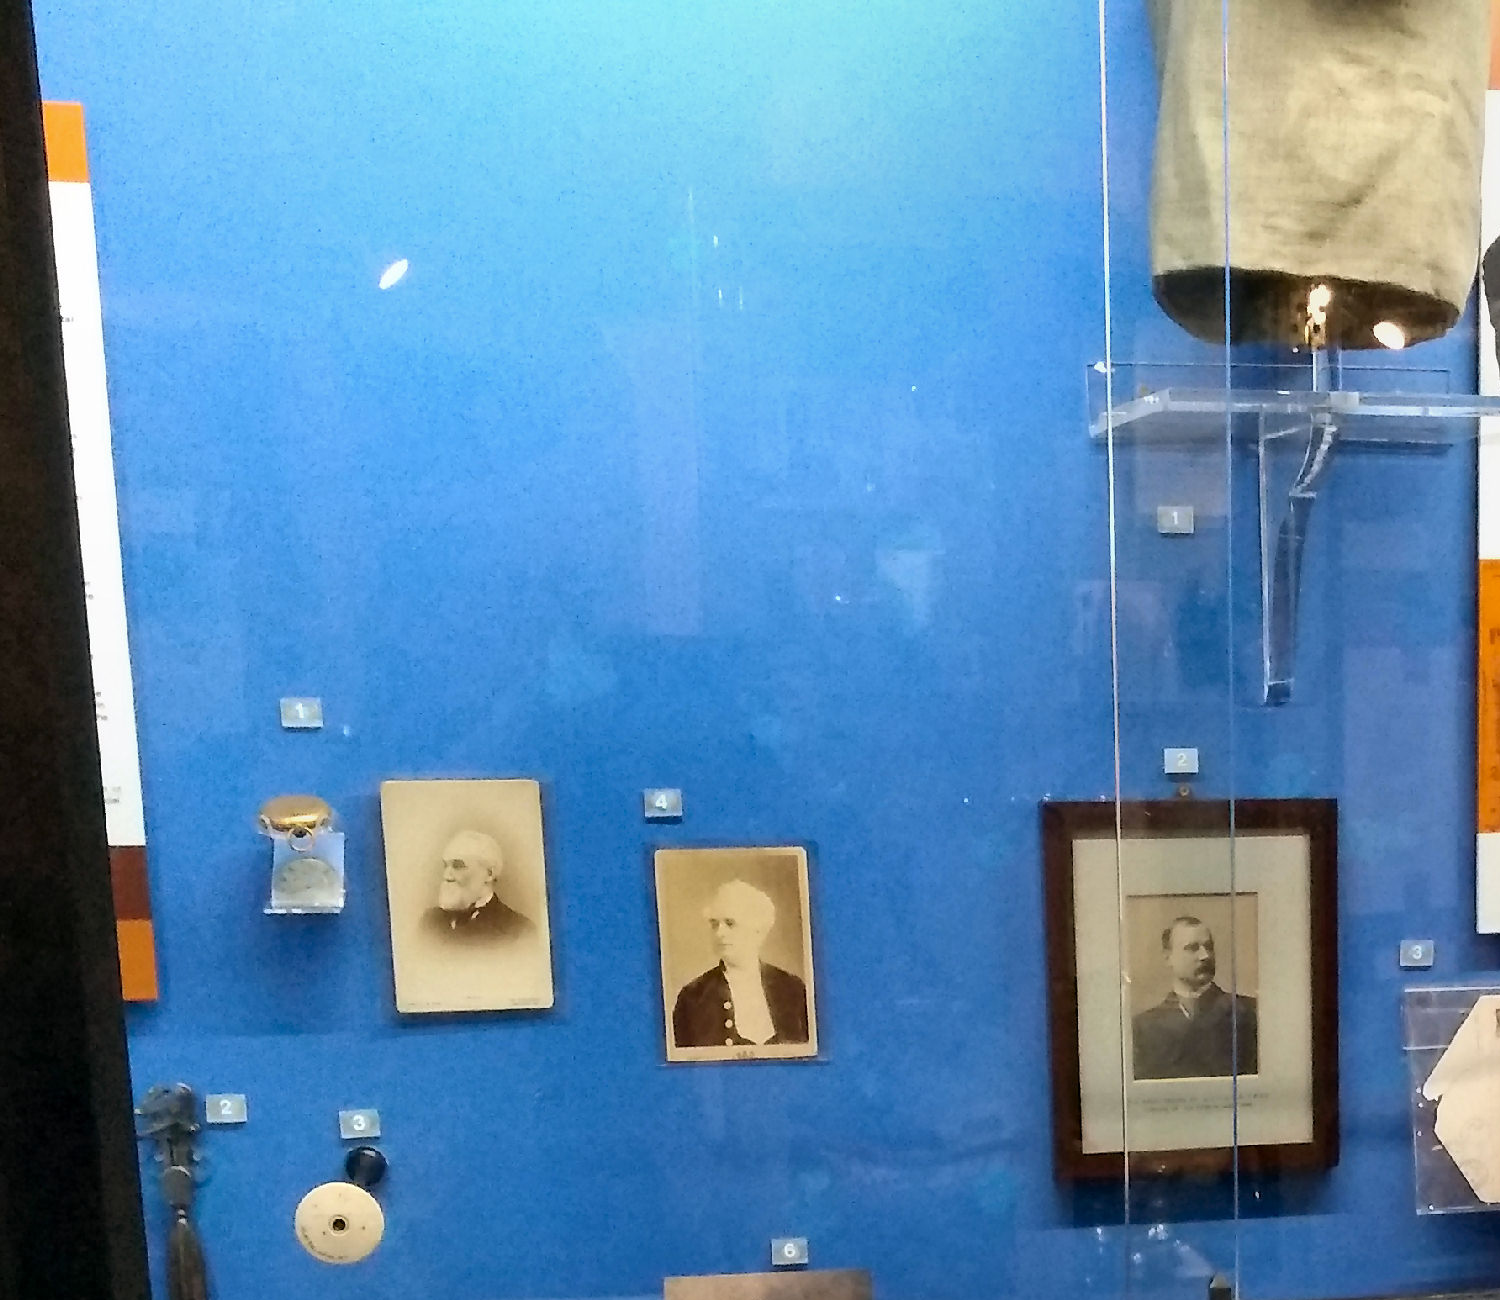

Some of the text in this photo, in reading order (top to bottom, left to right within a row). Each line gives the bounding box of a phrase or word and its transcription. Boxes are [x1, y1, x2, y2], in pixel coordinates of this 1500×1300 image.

[1171, 511, 1178, 525] 1
[296, 703, 304, 719] 1
[1177, 753, 1187, 767] 2
[655, 794, 667, 810] 4
[1412, 945, 1422, 960] 3
[220, 1100, 232, 1114] 2
[353, 1115, 366, 1130] 3
[784, 1243, 795, 1257] 6
